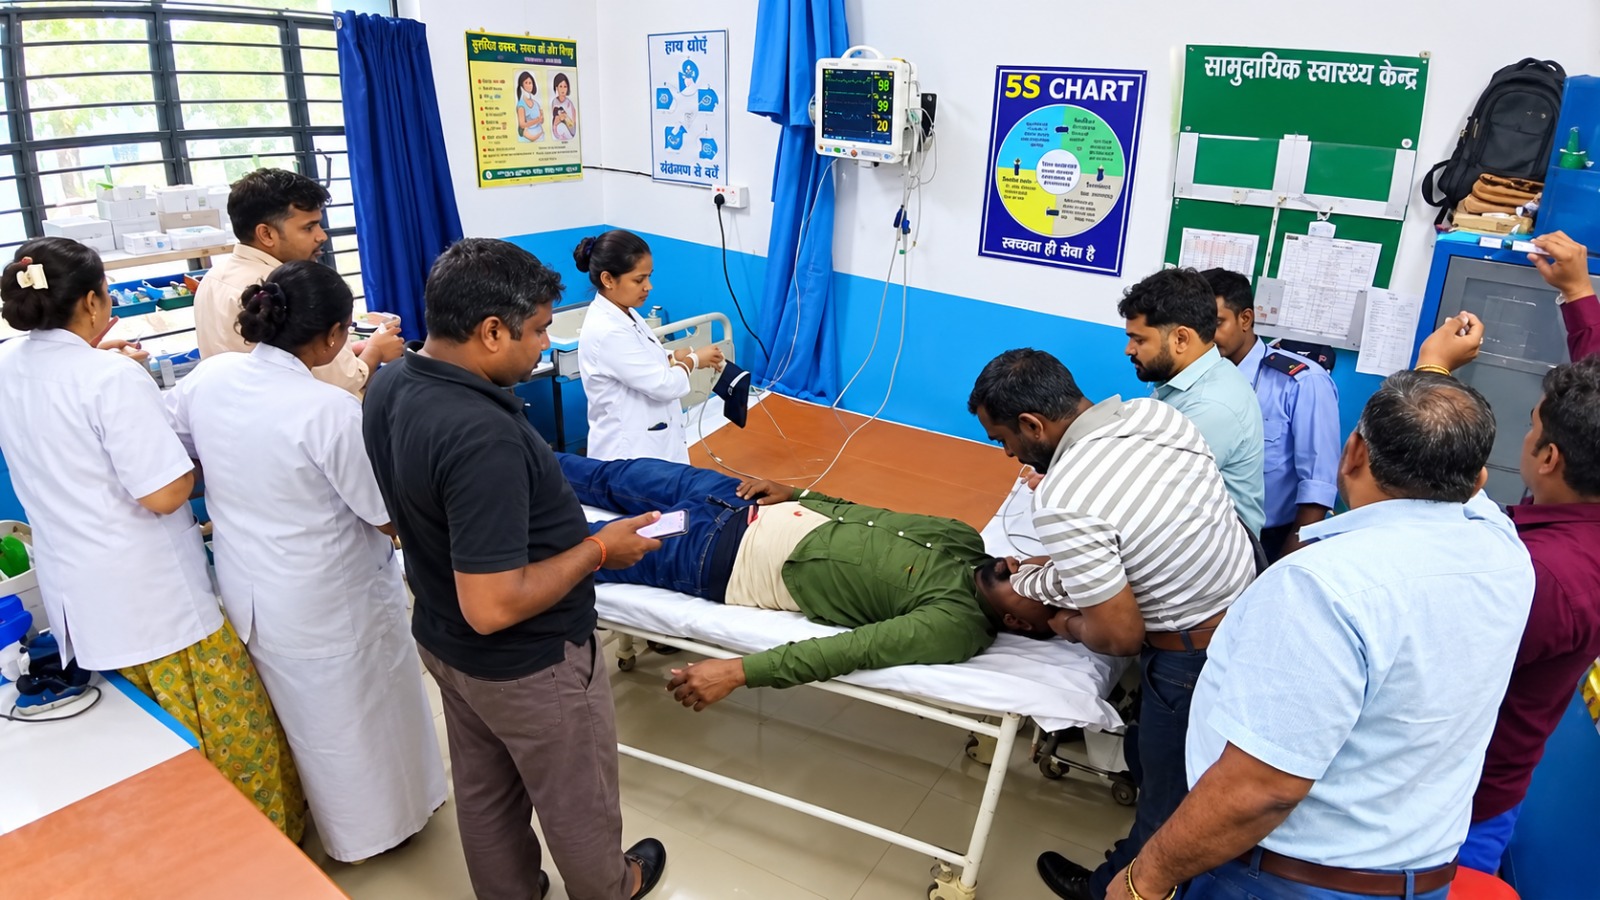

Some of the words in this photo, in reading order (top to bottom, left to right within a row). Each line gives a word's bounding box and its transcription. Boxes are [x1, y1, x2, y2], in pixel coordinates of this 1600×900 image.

[1204, 51, 1302, 87] सामुदायिक
[1306, 60, 1375, 86] स्वास्थ्य
[1379, 59, 1420, 90] केन्द्र
[878, 79, 889, 92] 98
[1004, 74, 1041, 99] 5S
[1049, 77, 1135, 102] CHART
[877, 100, 889, 112] 99
[876, 119, 888, 132] 20
[1044, 239, 1057, 257] ही
[1060, 242, 1083, 259] सेवा
[1086, 244, 1096, 262] है
